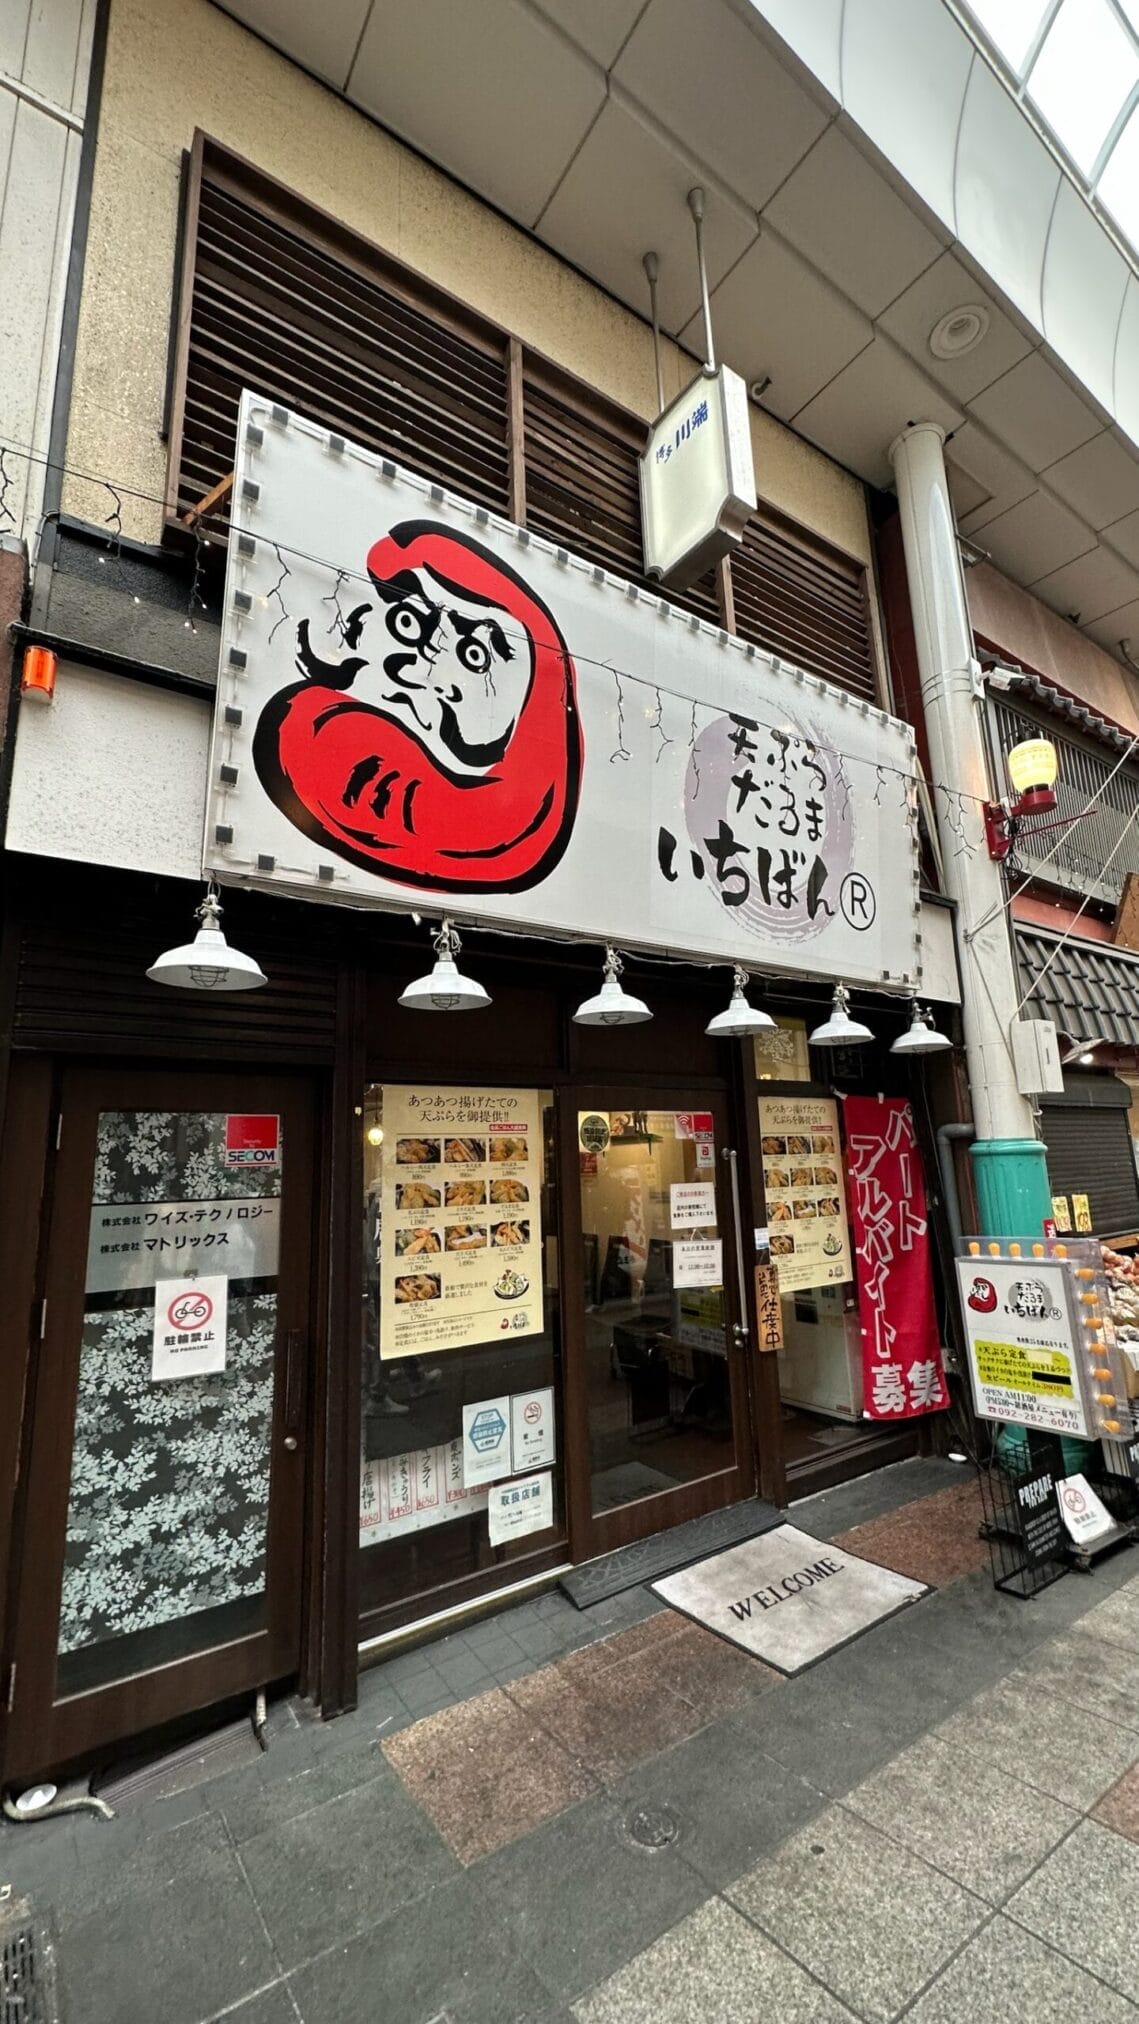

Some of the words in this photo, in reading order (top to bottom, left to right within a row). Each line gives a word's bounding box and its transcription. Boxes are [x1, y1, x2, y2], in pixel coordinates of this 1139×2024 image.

[731, 769, 824, 842] だるま
[658, 819, 835, 920] いちばん
[408, 1094, 518, 1109] あつあつ揚げたての
[228, 1150, 275, 1162] SECOM
[885, 1103, 927, 1251] パート
[102, 1215, 141, 1228] 株式会社
[144, 1206, 273, 1226] ワイズ・テクノロジー
[100, 1241, 140, 1254] 株式会社
[143, 1232, 229, 1251] マトリックス
[850, 1135, 897, 1358] アルバイト
[1004, 1301, 1049, 1319] いちばん
[164, 1332, 215, 1346] 駐輪禁止
[871, 1359, 944, 1413] 募集
[982, 1387, 1003, 1397] OPEN
[727, 1557, 845, 1622] WELCOME
